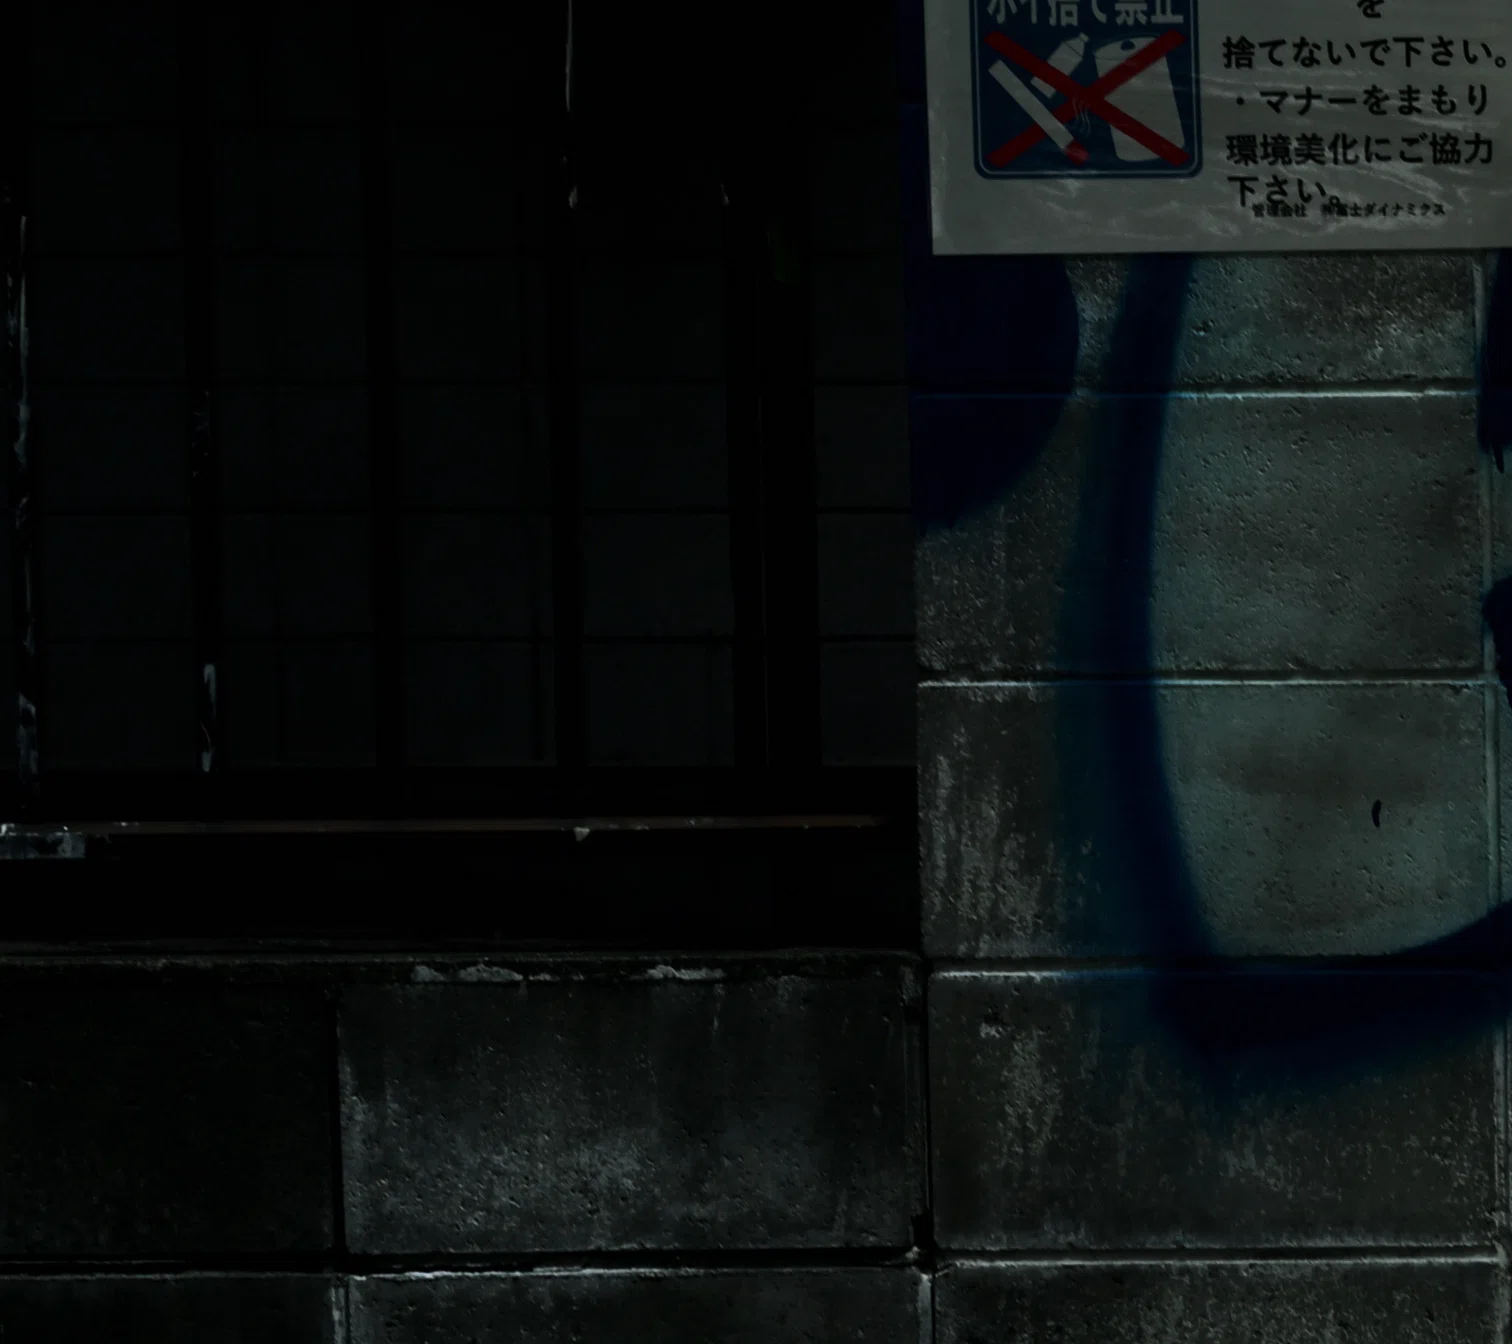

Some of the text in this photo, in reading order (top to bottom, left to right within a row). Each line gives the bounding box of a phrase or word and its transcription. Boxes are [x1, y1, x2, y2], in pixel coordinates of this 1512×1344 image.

[1222, 35, 1506, 69] 捨てないで下さい。
[1225, 131, 1493, 166] 環境美化にご協力
[1227, 174, 1340, 207] 下さい。
